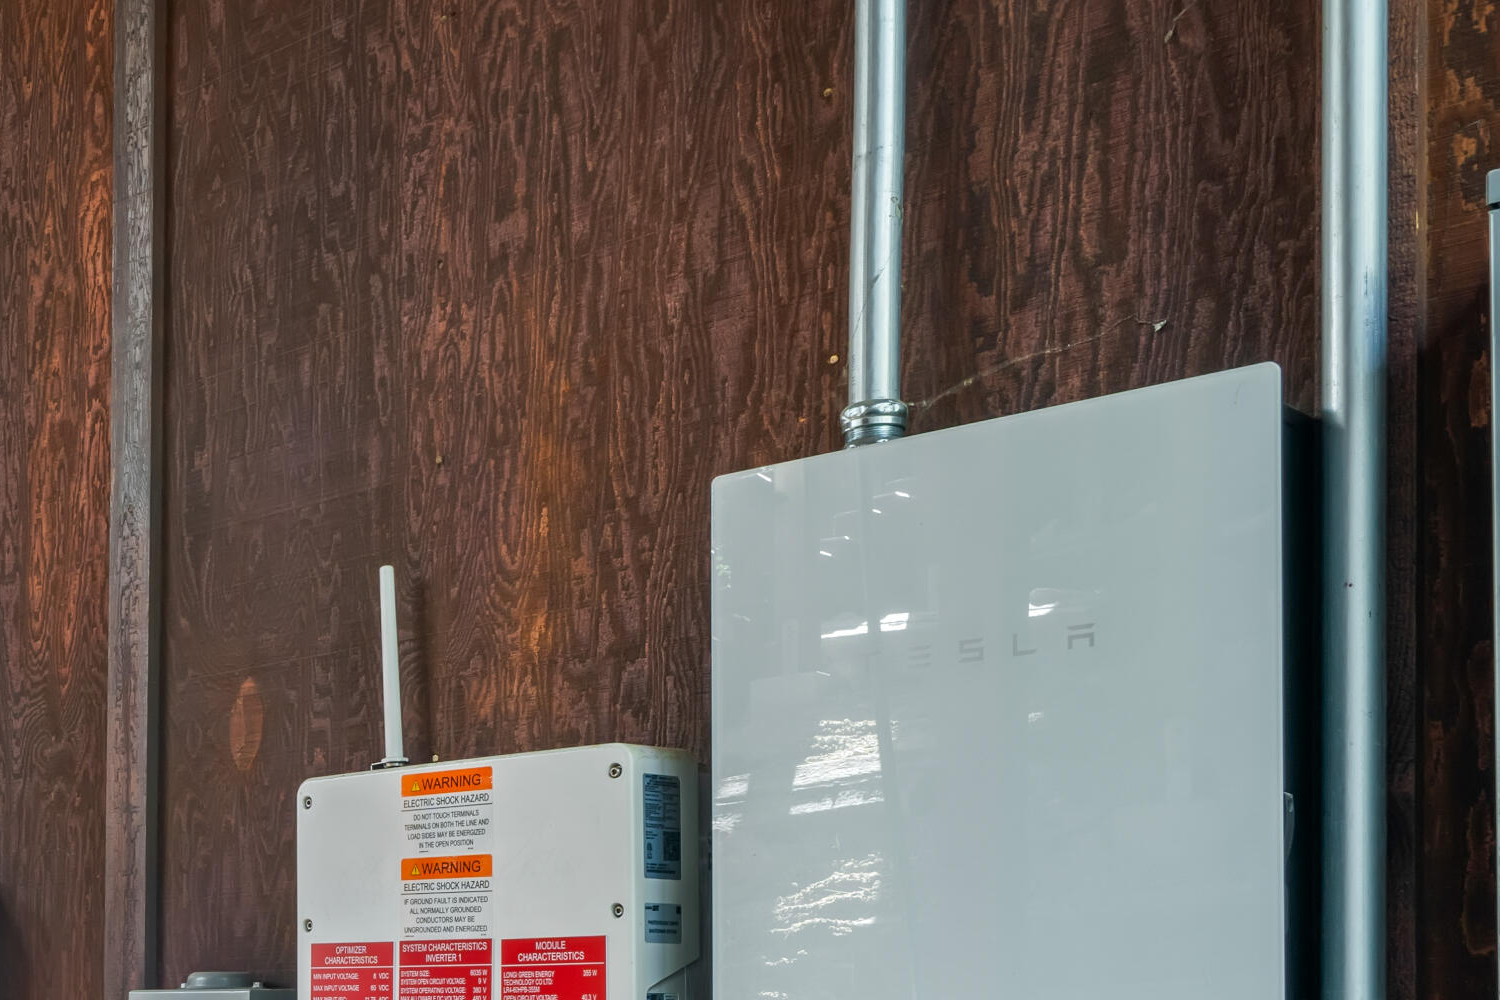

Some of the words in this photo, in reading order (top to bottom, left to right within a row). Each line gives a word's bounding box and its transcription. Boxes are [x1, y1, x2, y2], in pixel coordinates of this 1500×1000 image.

[862, 623, 1095, 672] TESLA
[422, 774, 481, 790] WARNING
[404, 799, 434, 808] ELECTRIC
[436, 796, 459, 806] SHOCK
[461, 793, 489, 803] HAZARD
[451, 810, 479, 818] TERMINALS
[405, 823, 431, 831] TERMINALS
[422, 860, 481, 874] WARNING
[404, 882, 434, 891] ELECTRIC
[437, 881, 459, 890] SHOCK
[461, 880, 489, 889] HAZARD
[336, 946, 367, 954] OPTIMIZER
[403, 944, 427, 952] SYSTEM
[428, 942, 487, 951] CHARACTERISTICS
[536, 941, 566, 950] MODULE
[325, 956, 378, 965] CHARACTERISTICS
[426, 954, 457, 962] INVERTER
[459, 953, 462, 961] 1
[518, 952, 585, 962] CHARACTERISTICS
